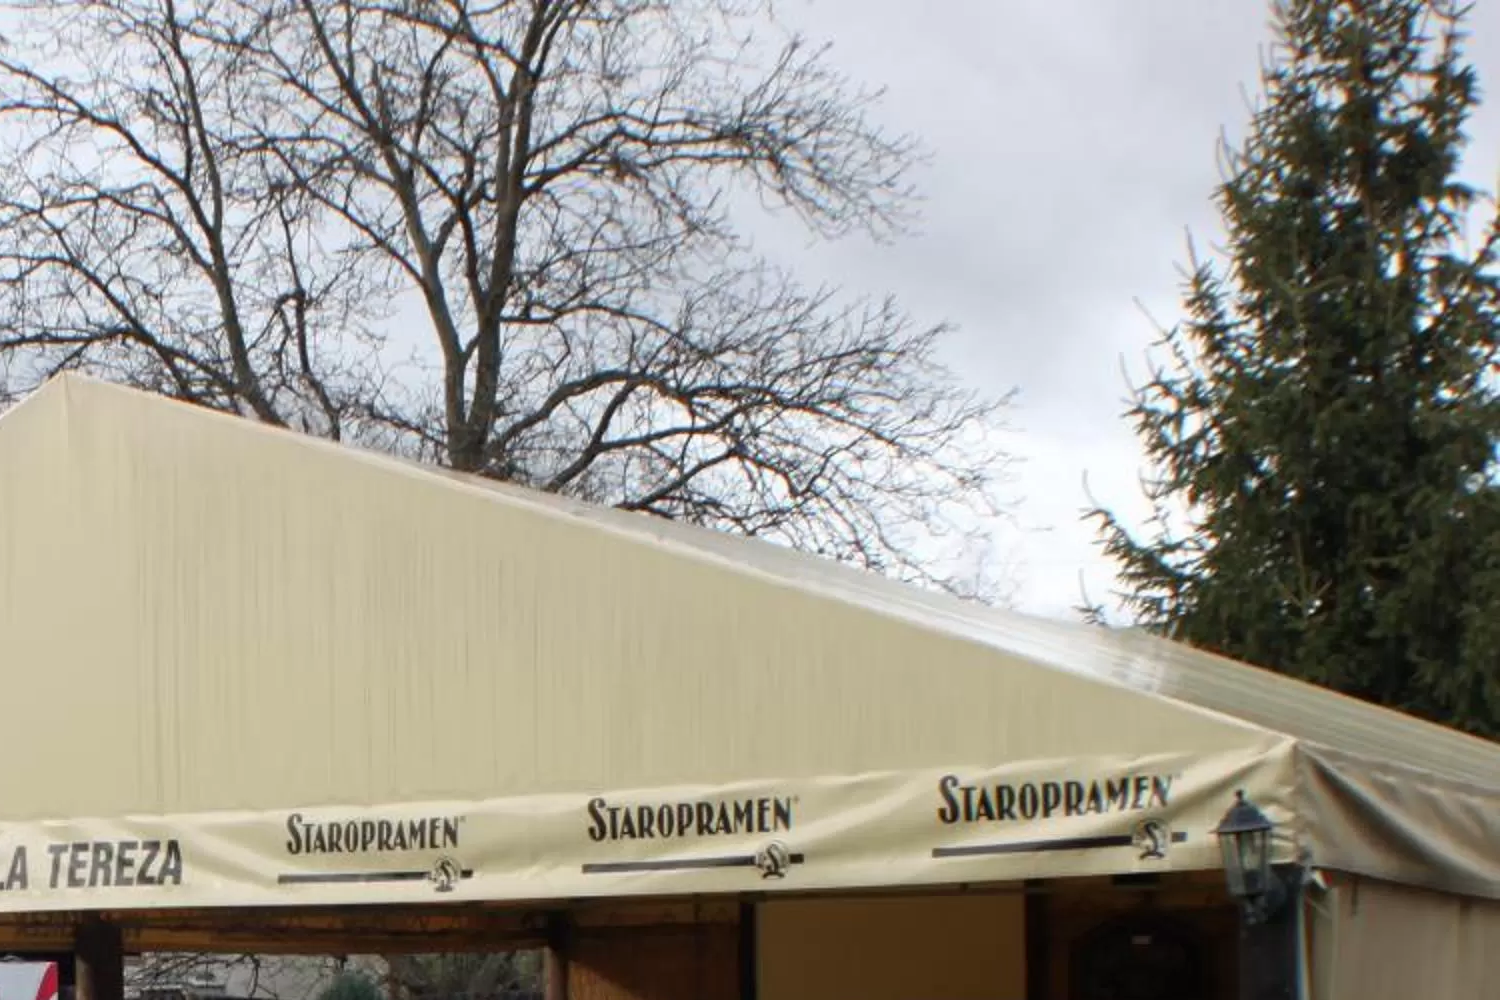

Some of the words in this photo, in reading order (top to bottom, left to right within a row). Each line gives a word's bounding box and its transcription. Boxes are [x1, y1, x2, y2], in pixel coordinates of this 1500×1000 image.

[587, 797, 792, 842] STAROPRAMEN
[937, 774, 1172, 825] STAROPRAMEN
[286, 813, 459, 856] STAROPRAMEN
[48, 839, 182, 888] TEREZA
